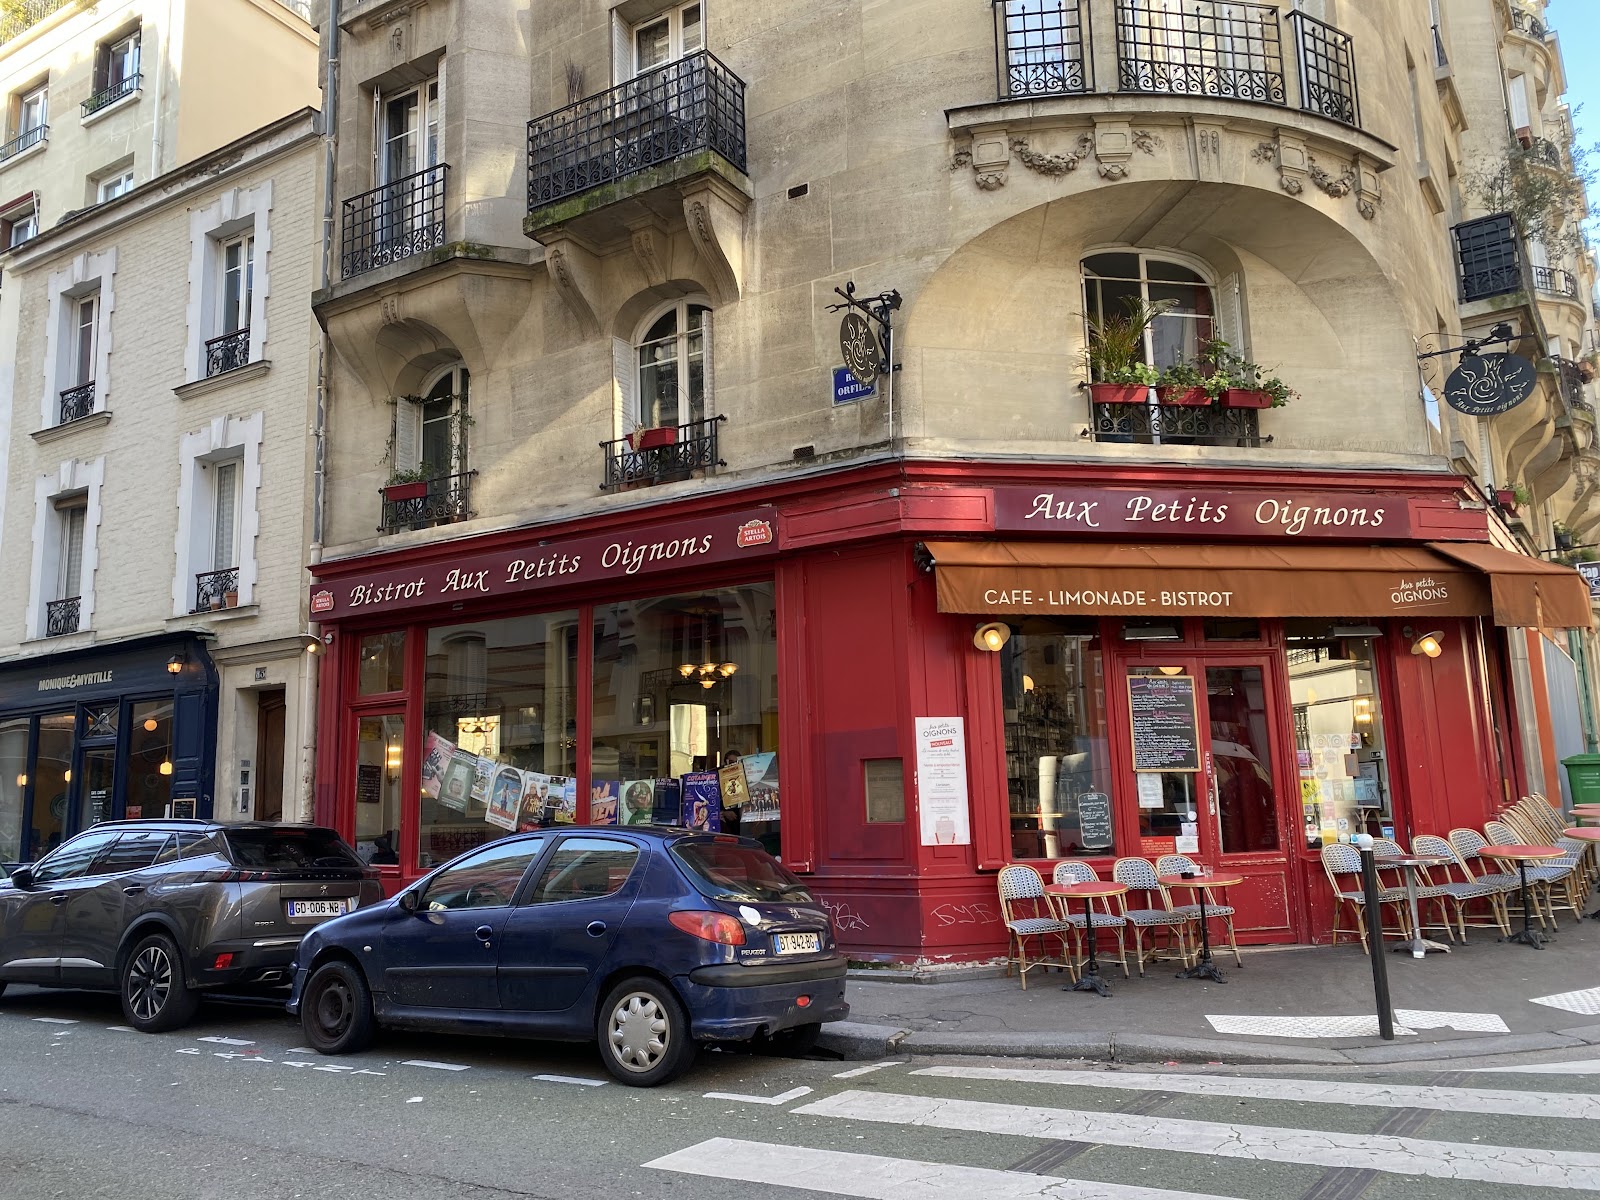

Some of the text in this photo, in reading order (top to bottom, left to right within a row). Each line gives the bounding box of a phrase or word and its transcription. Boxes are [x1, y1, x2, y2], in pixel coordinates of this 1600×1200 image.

[1024, 493, 1385, 535] Aux Petits Oignons
[744, 527, 765, 536] STELLA
[744, 534, 766, 542] ARTOIS
[349, 534, 713, 607] Bistrot Aux Petits Oignons
[1400, 577, 1436, 590] Aux petits
[984, 590, 1033, 605] CAFE
[1049, 590, 1147, 606] LIMONADE
[1161, 591, 1233, 606] BISTROT
[1391, 587, 1448, 603] OIGNONS
[923, 728, 957, 738] OIGNONS
